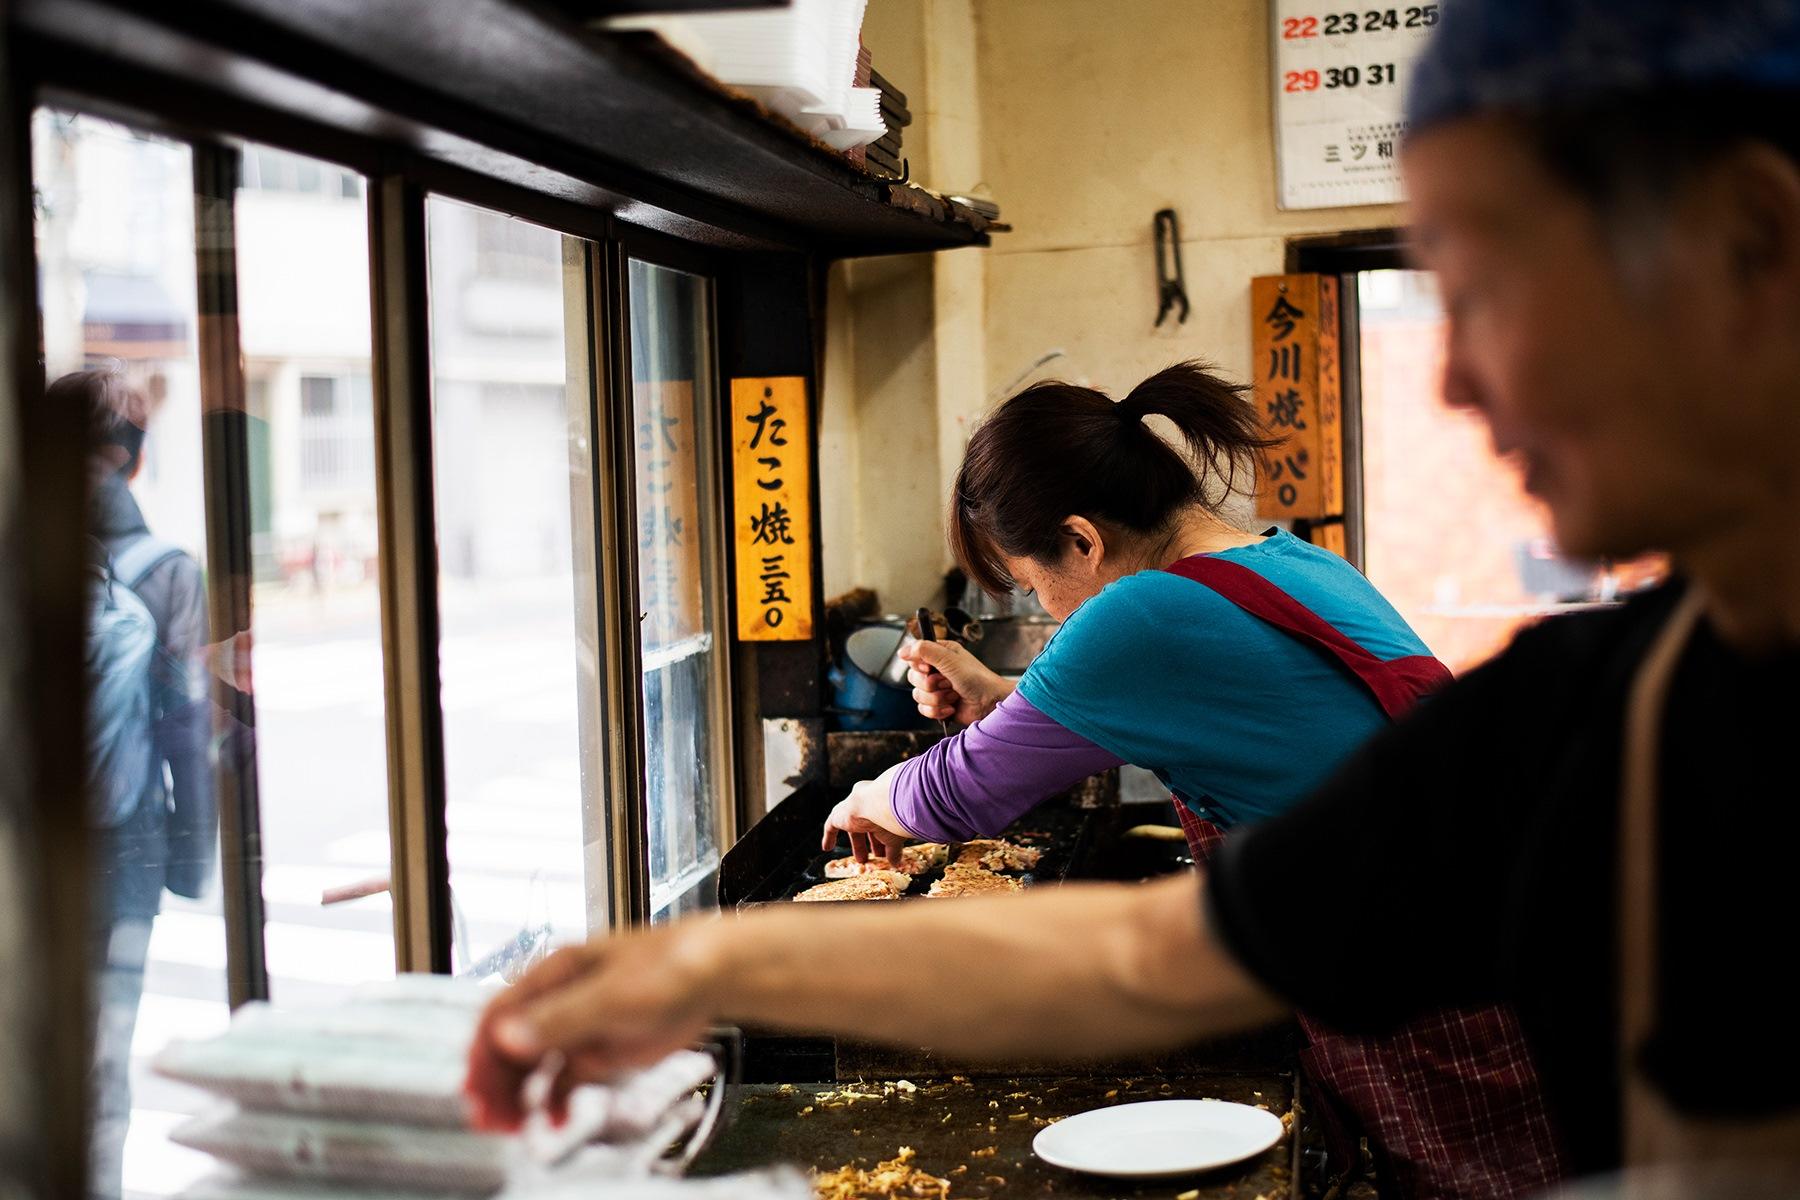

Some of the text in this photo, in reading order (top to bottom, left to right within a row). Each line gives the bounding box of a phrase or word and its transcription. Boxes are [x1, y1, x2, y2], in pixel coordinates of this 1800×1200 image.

[1283, 5, 1439, 39] 22 23 24 25
[1285, 64, 1396, 93] 29 30 31
